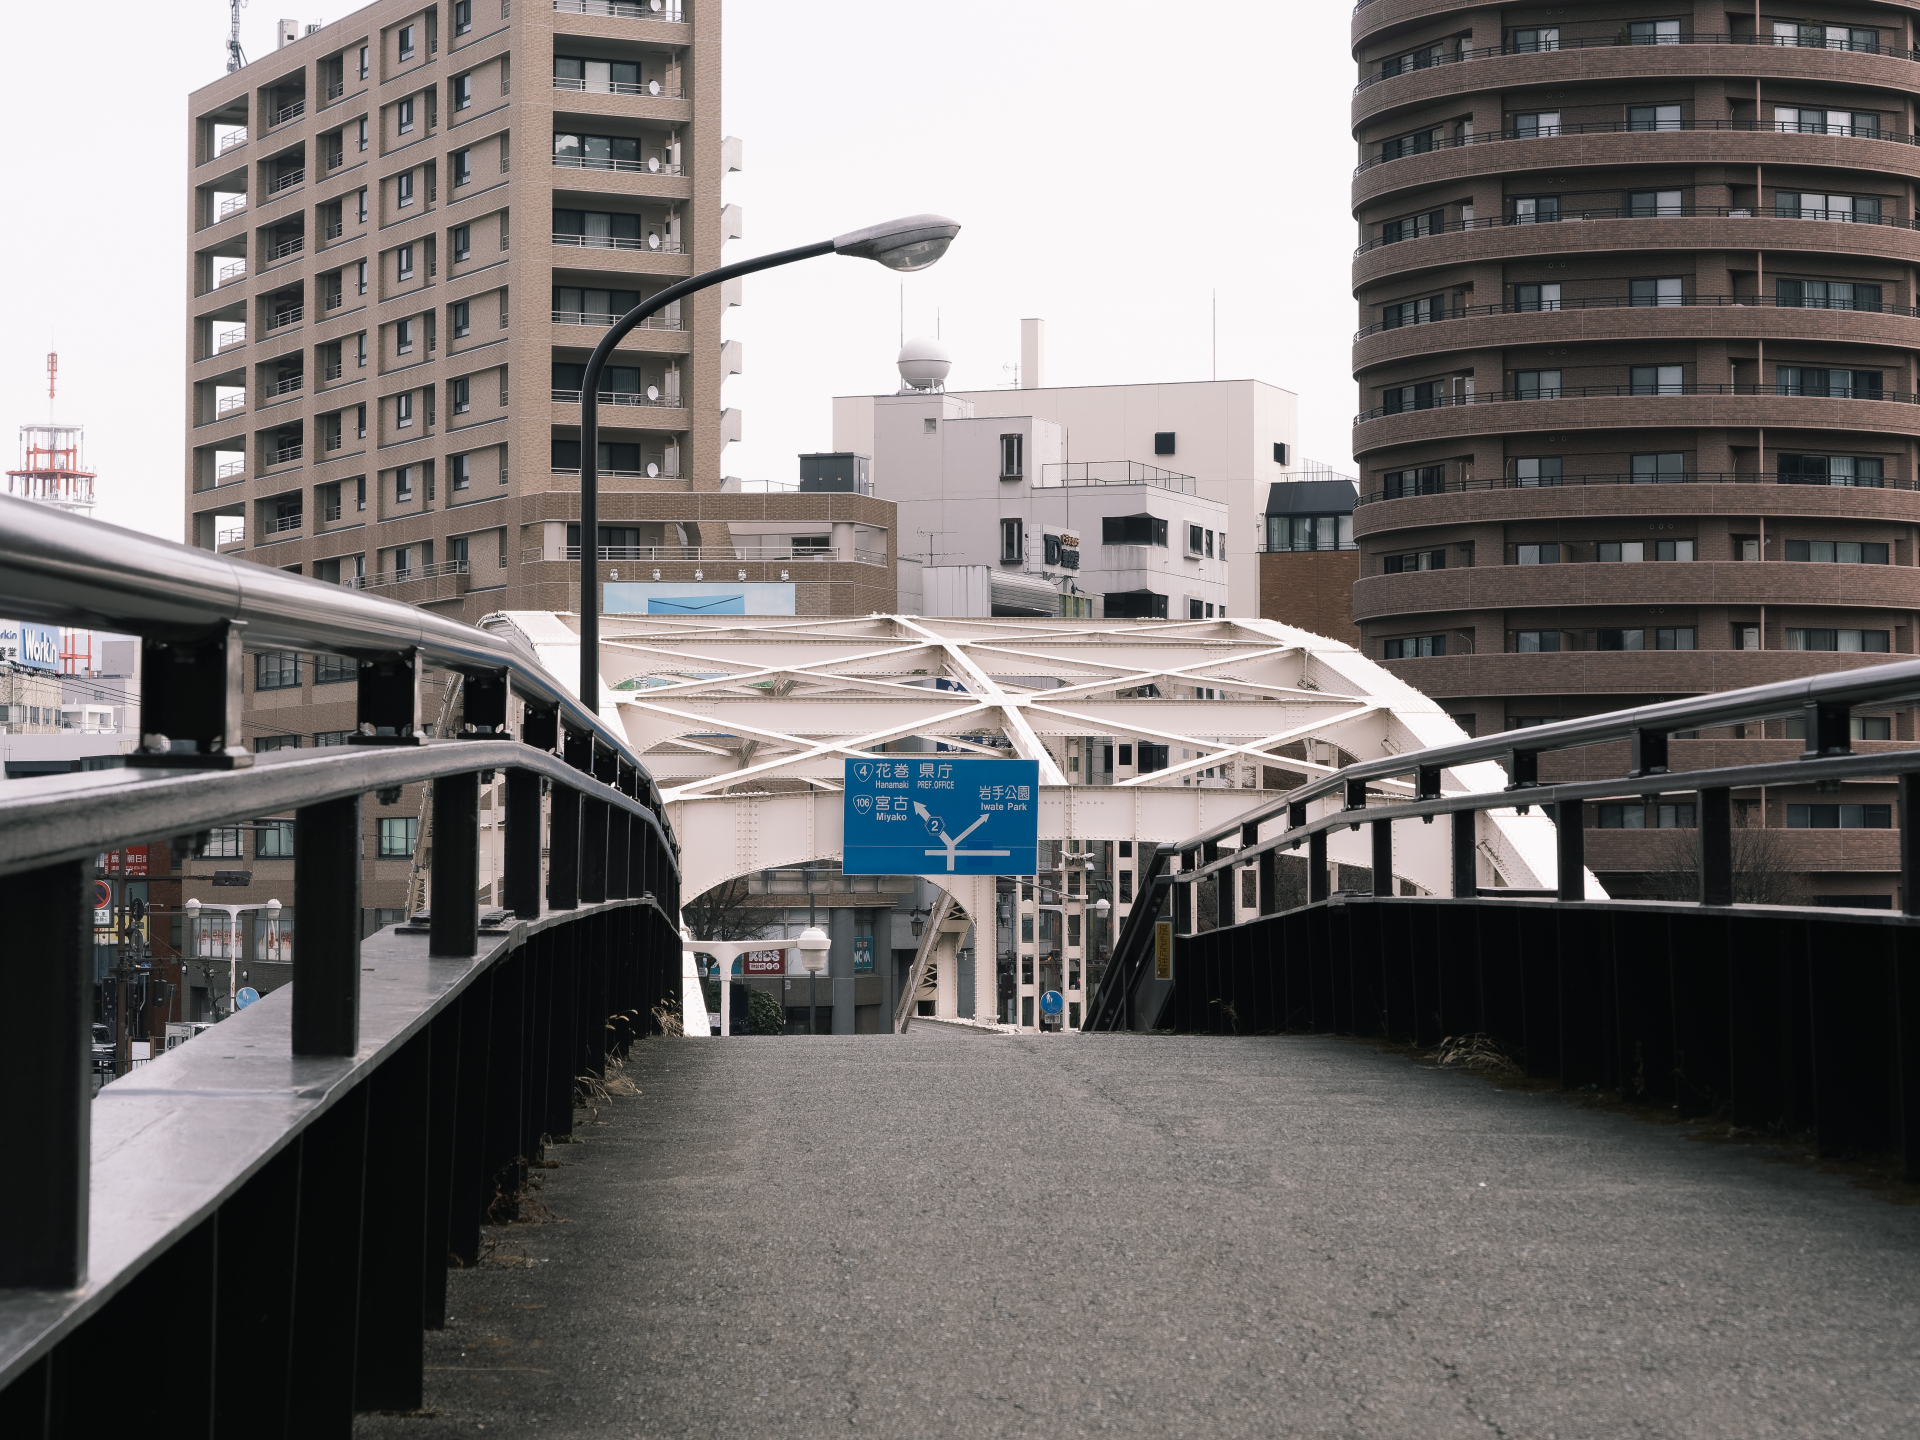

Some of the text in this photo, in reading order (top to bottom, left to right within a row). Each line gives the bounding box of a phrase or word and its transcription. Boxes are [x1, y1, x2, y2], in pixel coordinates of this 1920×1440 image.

[22, 628, 57, 664] Workin
[859, 765, 868, 776] 4
[876, 763, 953, 779] 花巻 県庁
[875, 780, 955, 790] Hanamaki PREF.OFFICE
[978, 785, 1030, 801] 岩手公園
[856, 798, 870, 808] 106
[875, 795, 909, 811] 宮古
[980, 802, 1028, 811] Iwate Park
[876, 812, 907, 823] Miyako
[931, 820, 939, 832] 2
[748, 950, 780, 962] KIDS
[1158, 924, 1169, 978] 足もとに注意
